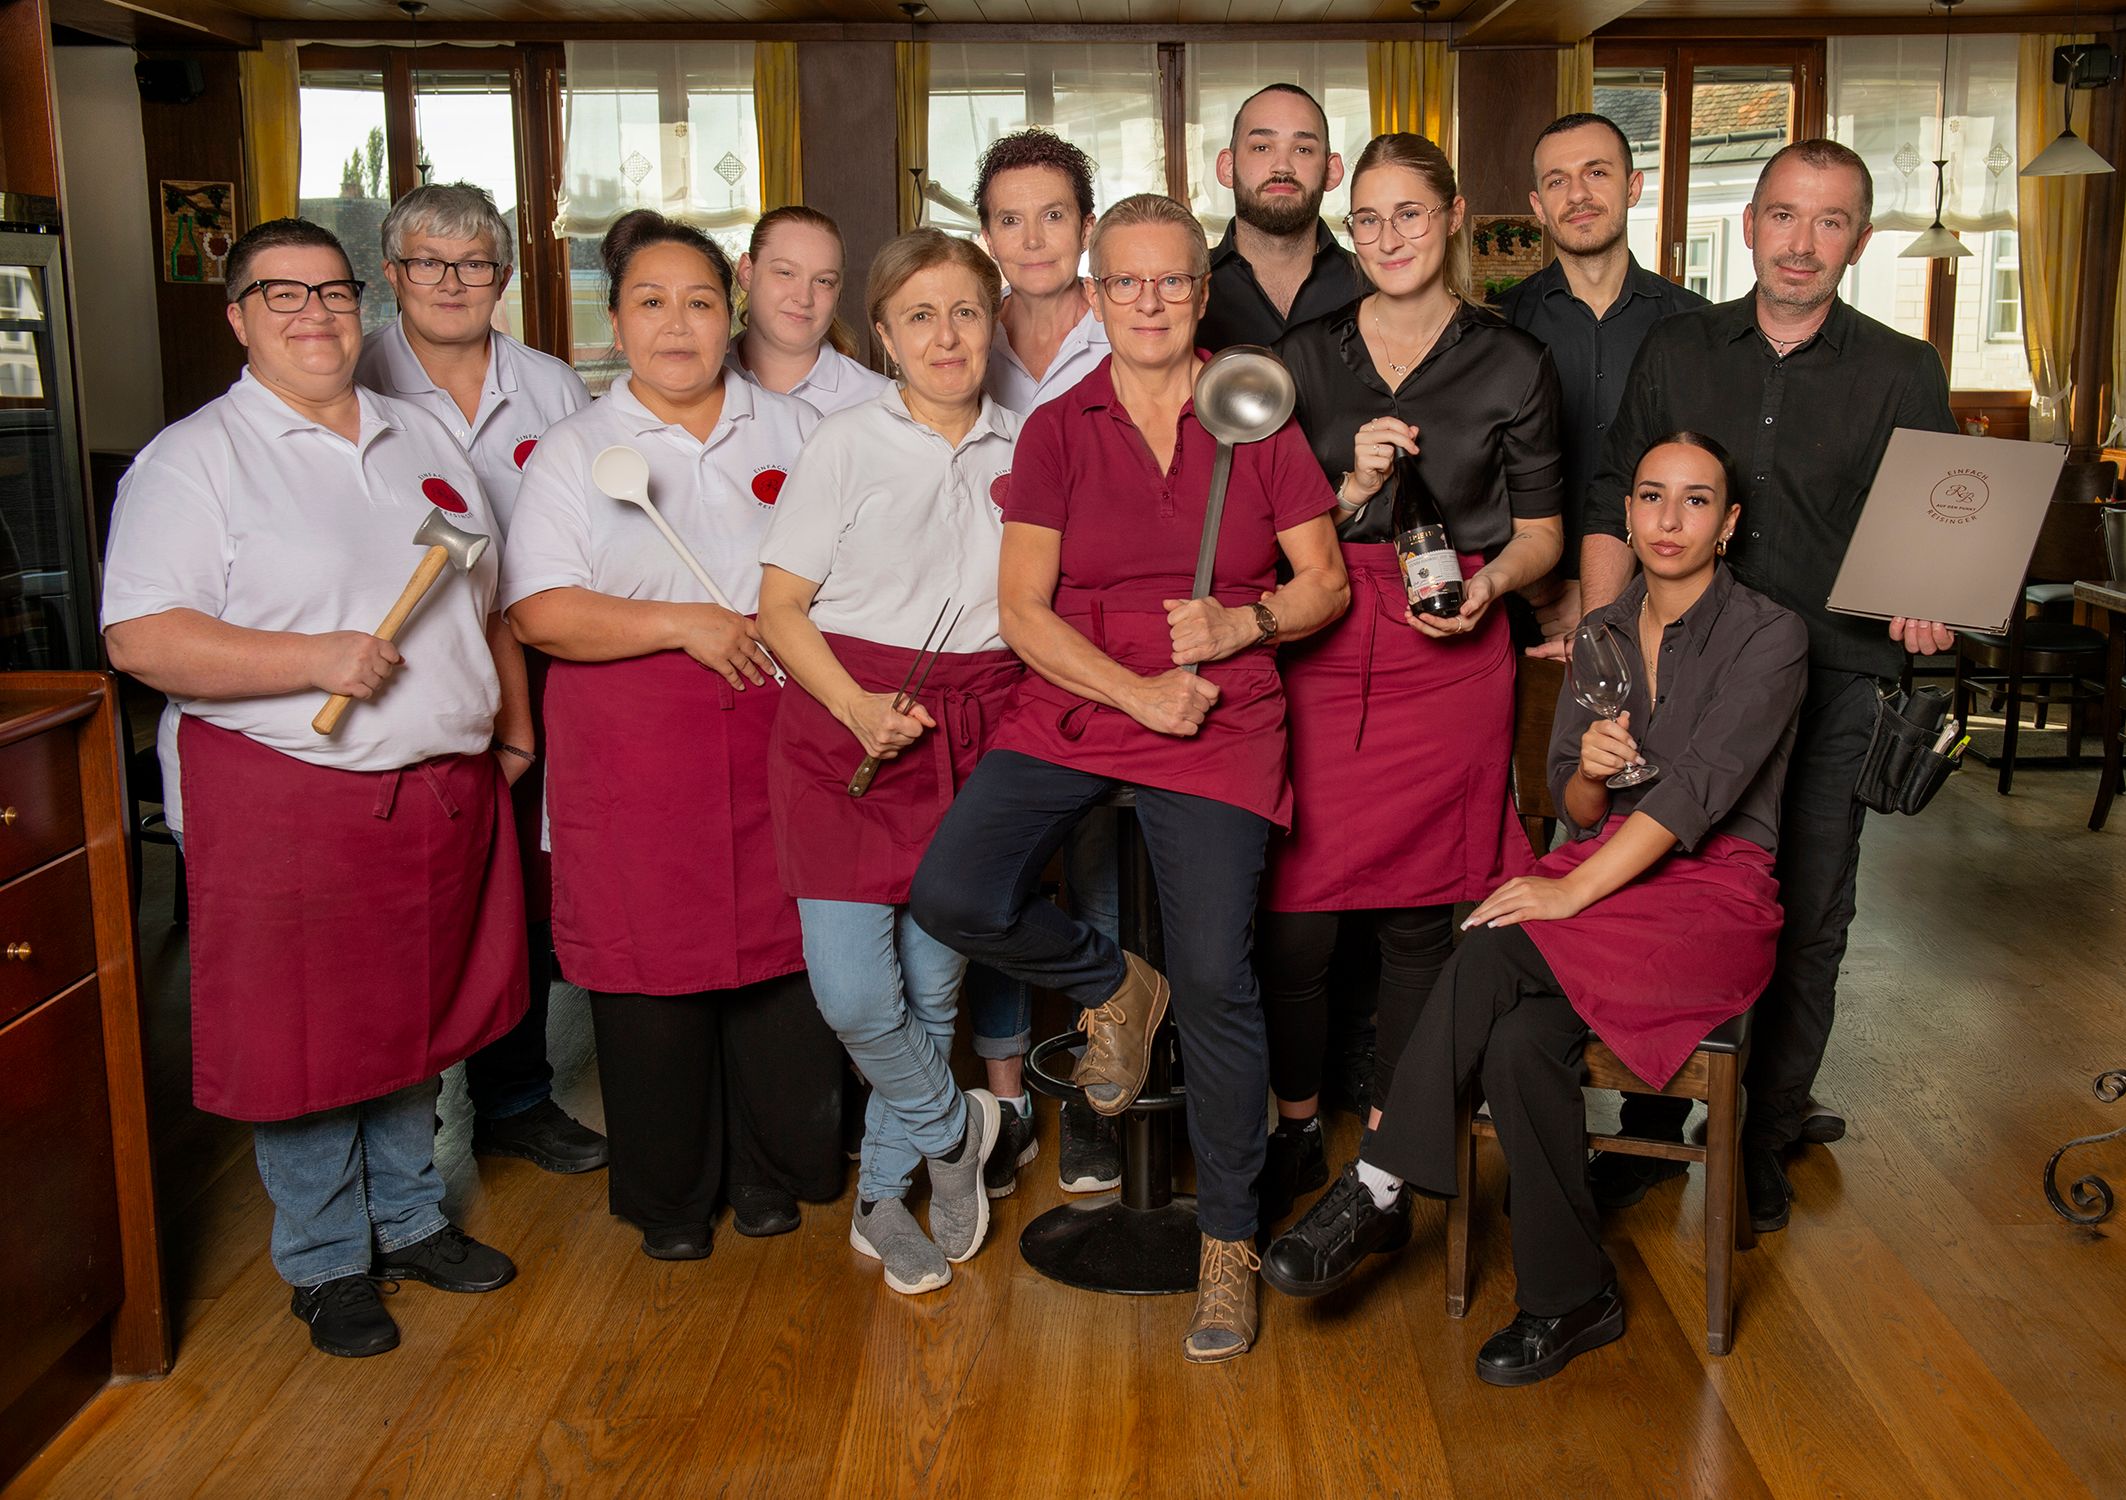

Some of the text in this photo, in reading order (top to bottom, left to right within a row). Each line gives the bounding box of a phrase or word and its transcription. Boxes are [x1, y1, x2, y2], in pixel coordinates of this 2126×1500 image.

[753, 464, 788, 474] EINFACH
[1947, 468, 1989, 481] EINFACH
[1927, 509, 1977, 525] REISINGER
